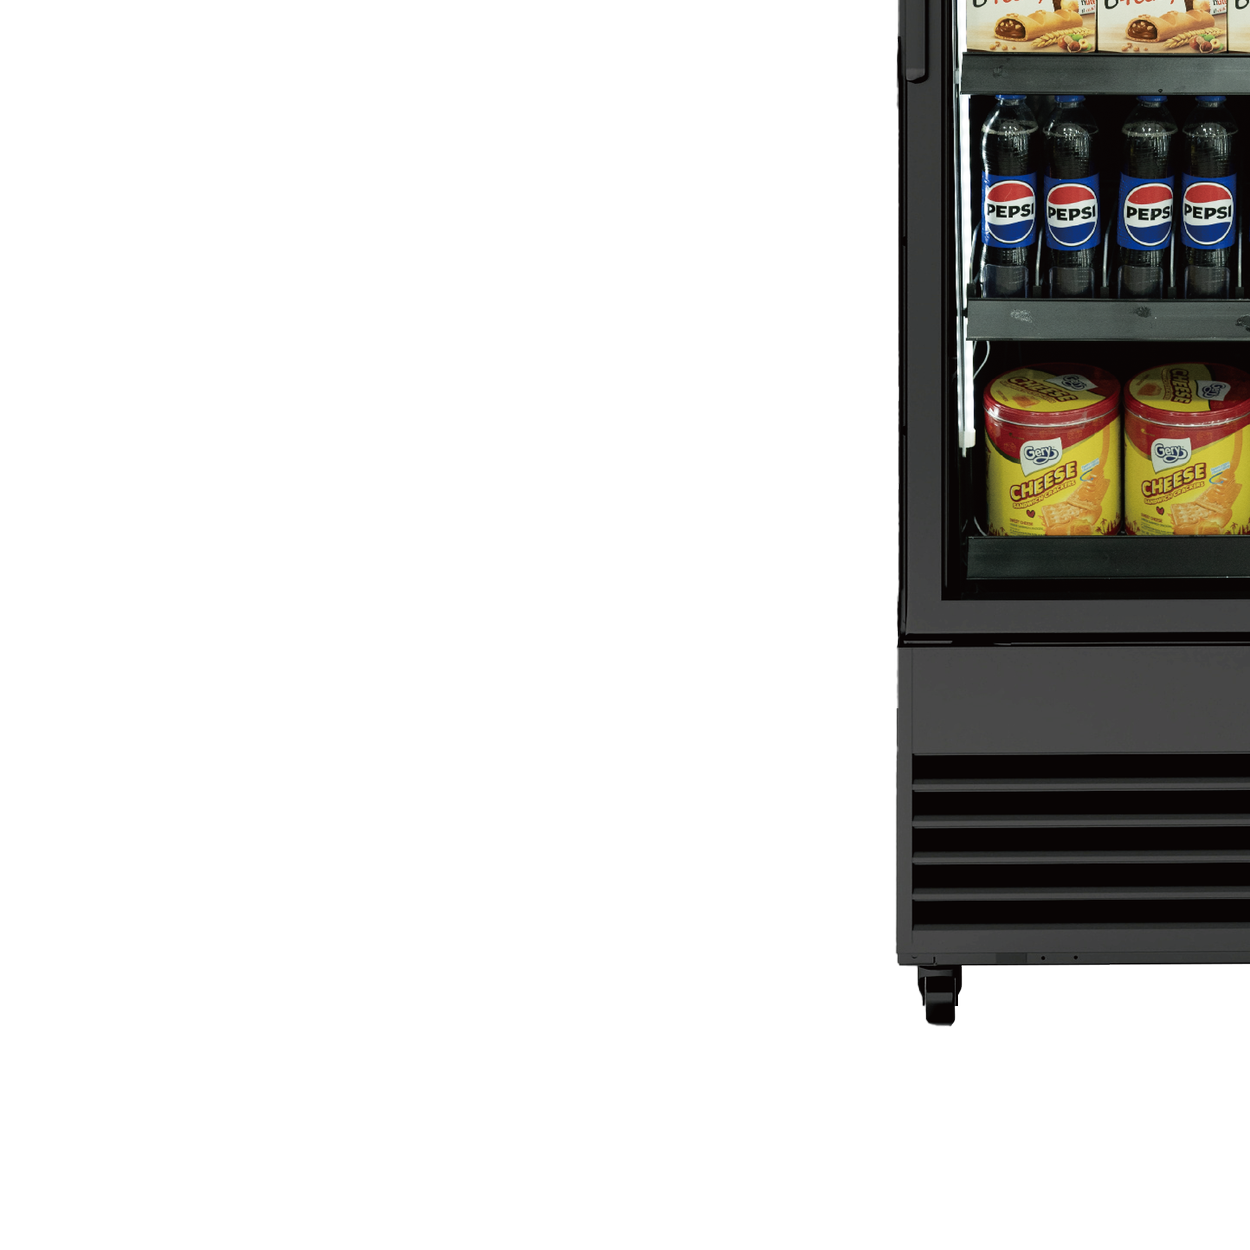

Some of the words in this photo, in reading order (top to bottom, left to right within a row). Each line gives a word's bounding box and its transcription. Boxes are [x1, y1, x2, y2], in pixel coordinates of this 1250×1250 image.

[987, 204, 1034, 219] PEPSI
[1048, 206, 1096, 221] PEPSI
[1184, 205, 1231, 220] PEPSI
[1008, 377, 1079, 402] CHEESE
[1170, 368, 1193, 404] CHEESE
[1024, 445, 1059, 465] Gery
[1154, 443, 1188, 464] Gery
[1010, 460, 1077, 502] CHEESE
[1141, 462, 1206, 498] CHEESE
[1013, 495, 1044, 510] SANDWICH
[1144, 492, 1173, 505] SANDWICH
